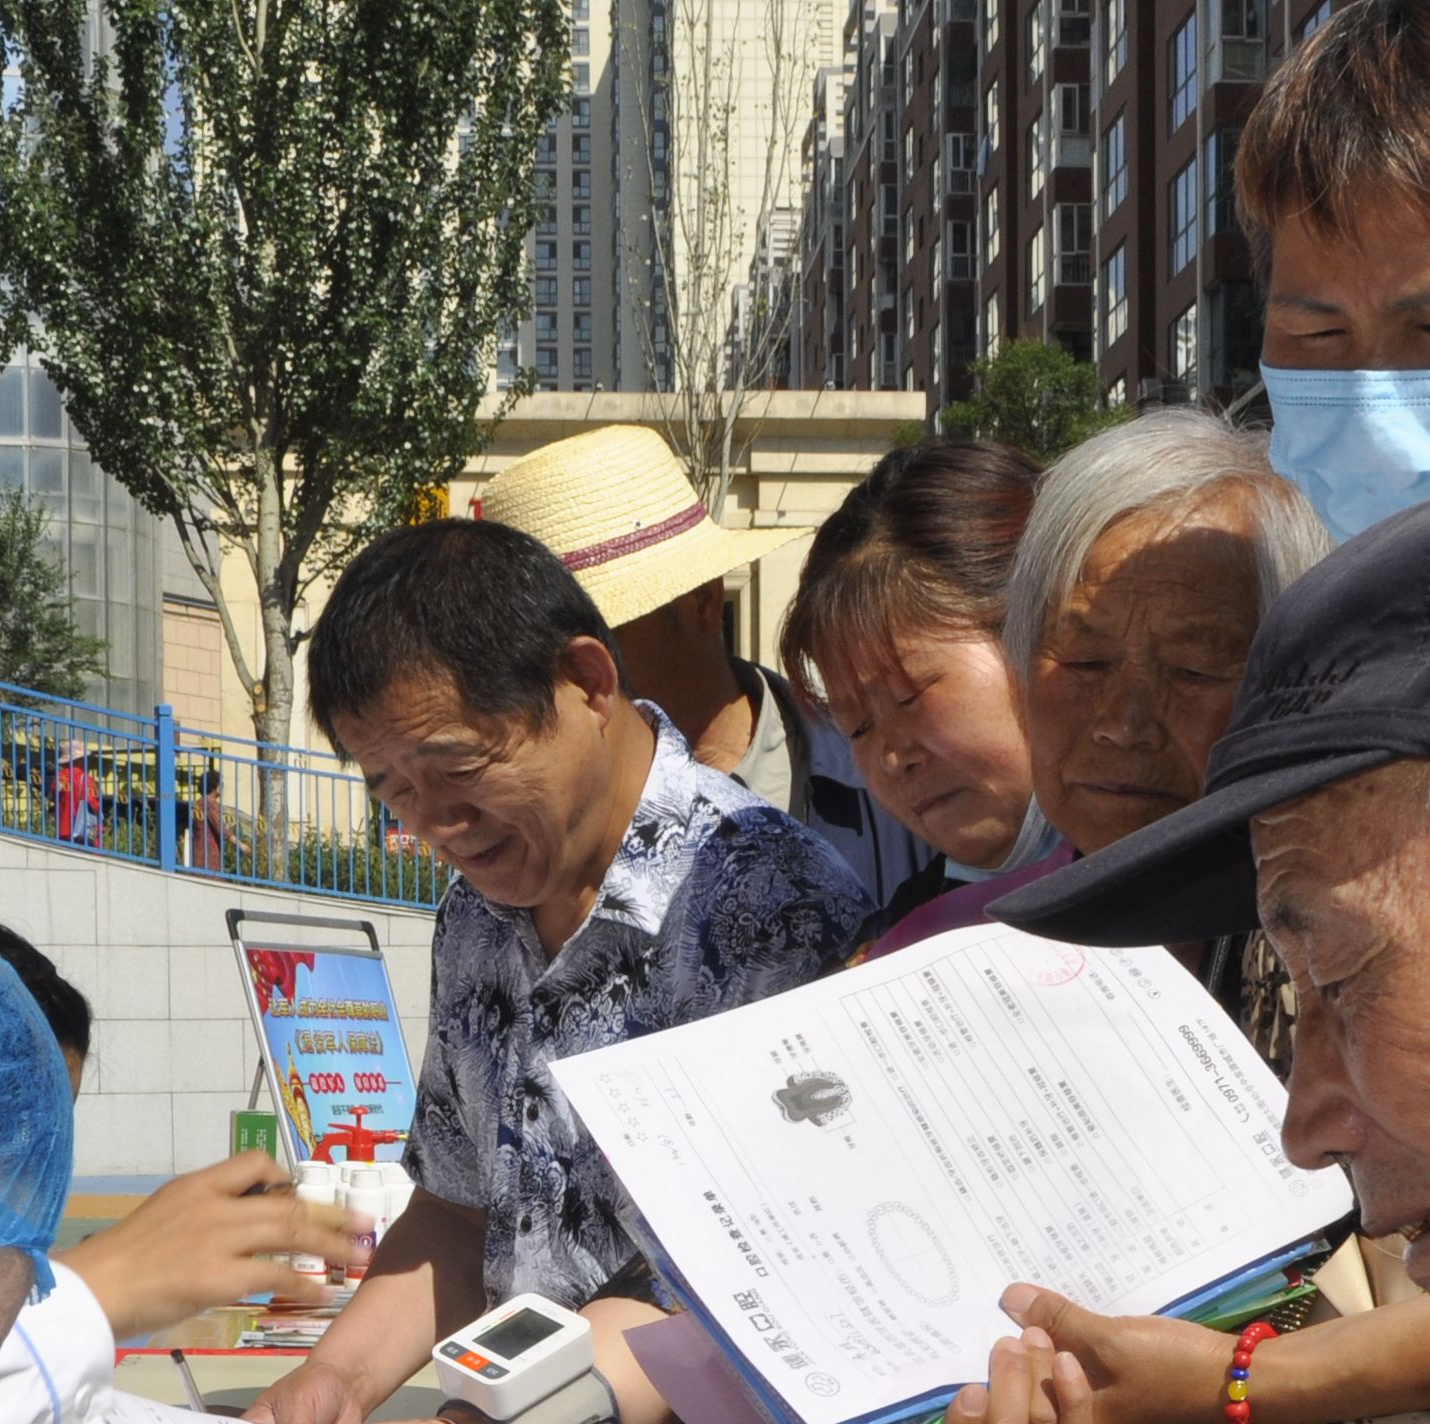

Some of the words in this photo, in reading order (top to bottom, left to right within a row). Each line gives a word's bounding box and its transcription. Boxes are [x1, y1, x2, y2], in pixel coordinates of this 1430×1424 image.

[1177, 1021, 1239, 1104] 0971-3669999
[702, 1188, 769, 1278] 口腔检查记录单
